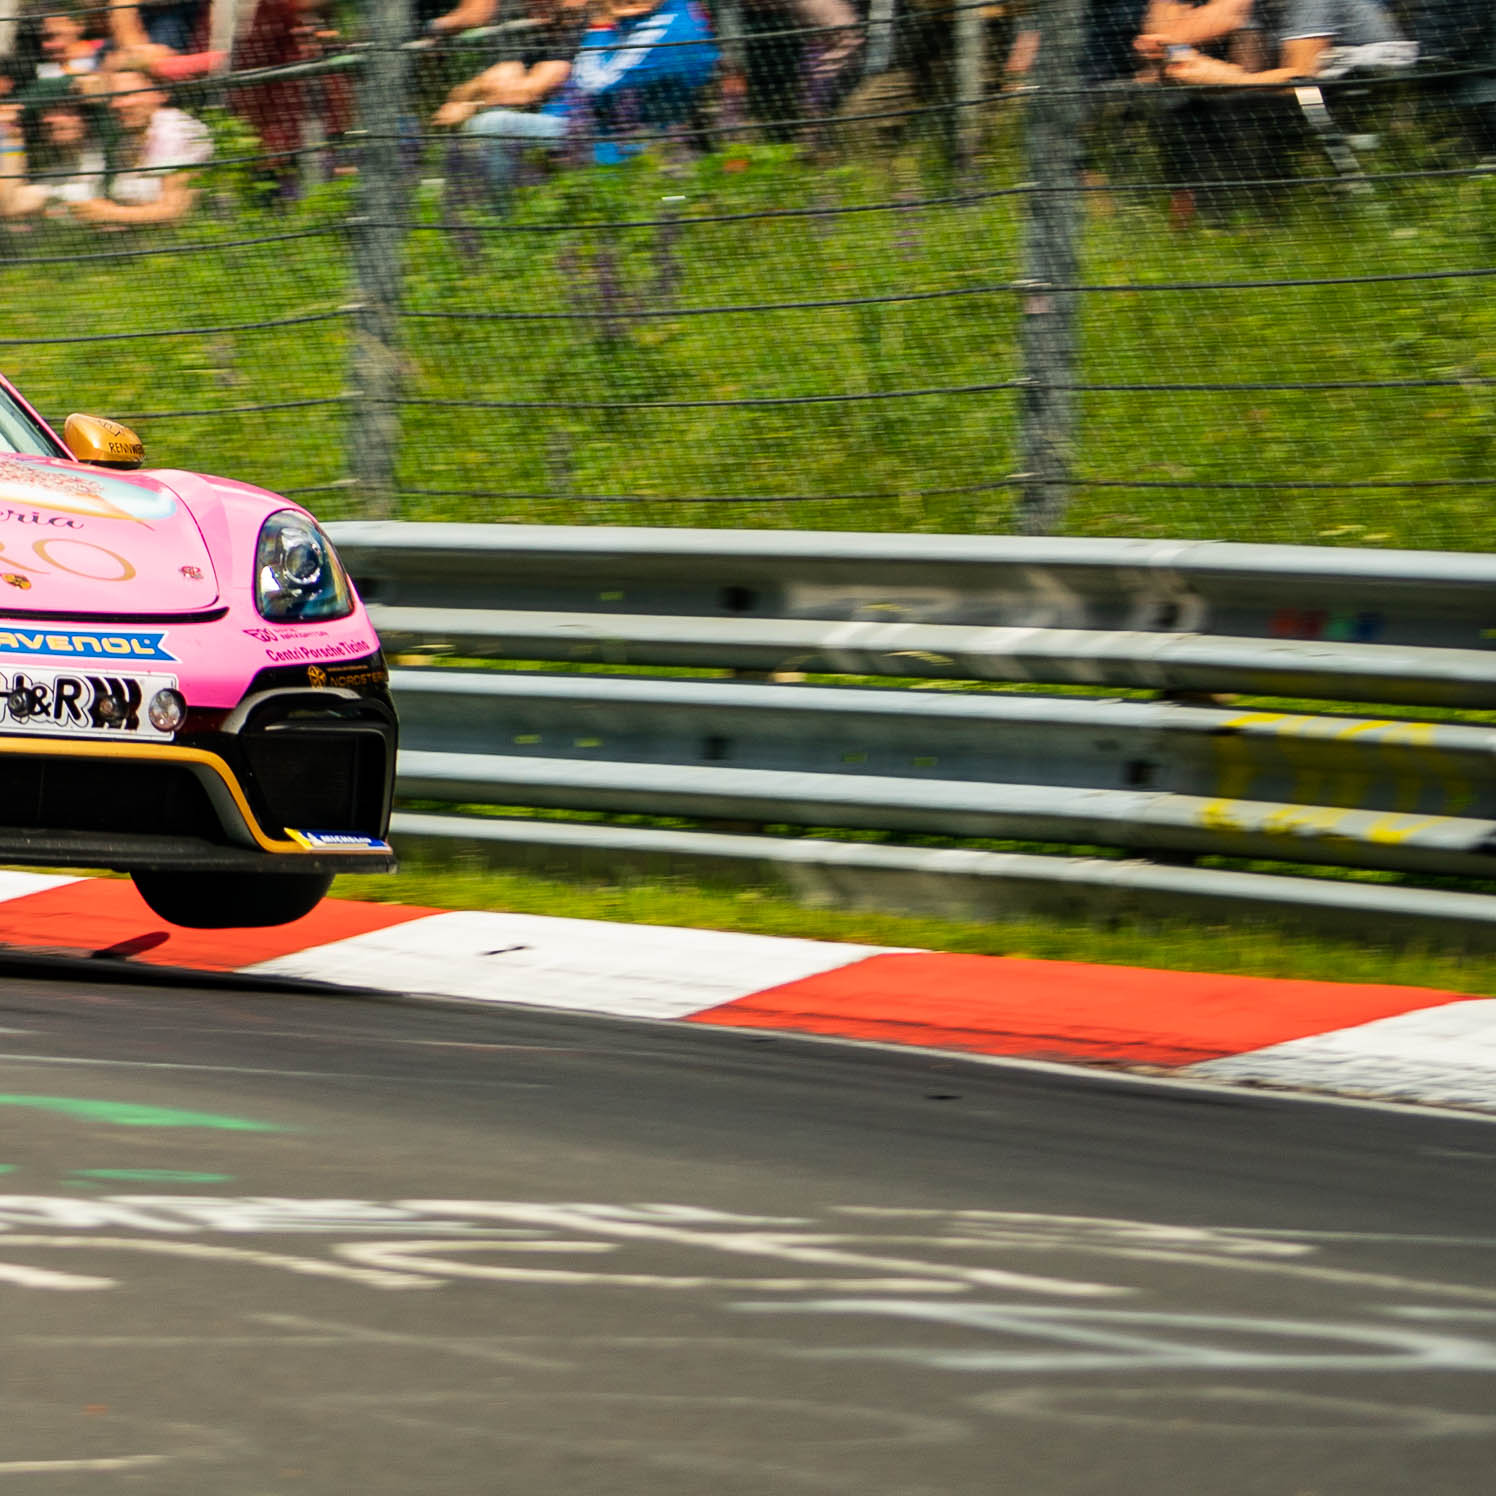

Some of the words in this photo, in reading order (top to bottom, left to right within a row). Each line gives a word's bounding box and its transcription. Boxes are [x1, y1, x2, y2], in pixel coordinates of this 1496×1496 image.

[265, 646, 302, 662] Centri
[300, 644, 344, 659] Porsche
[339, 639, 371, 656] Ticino
